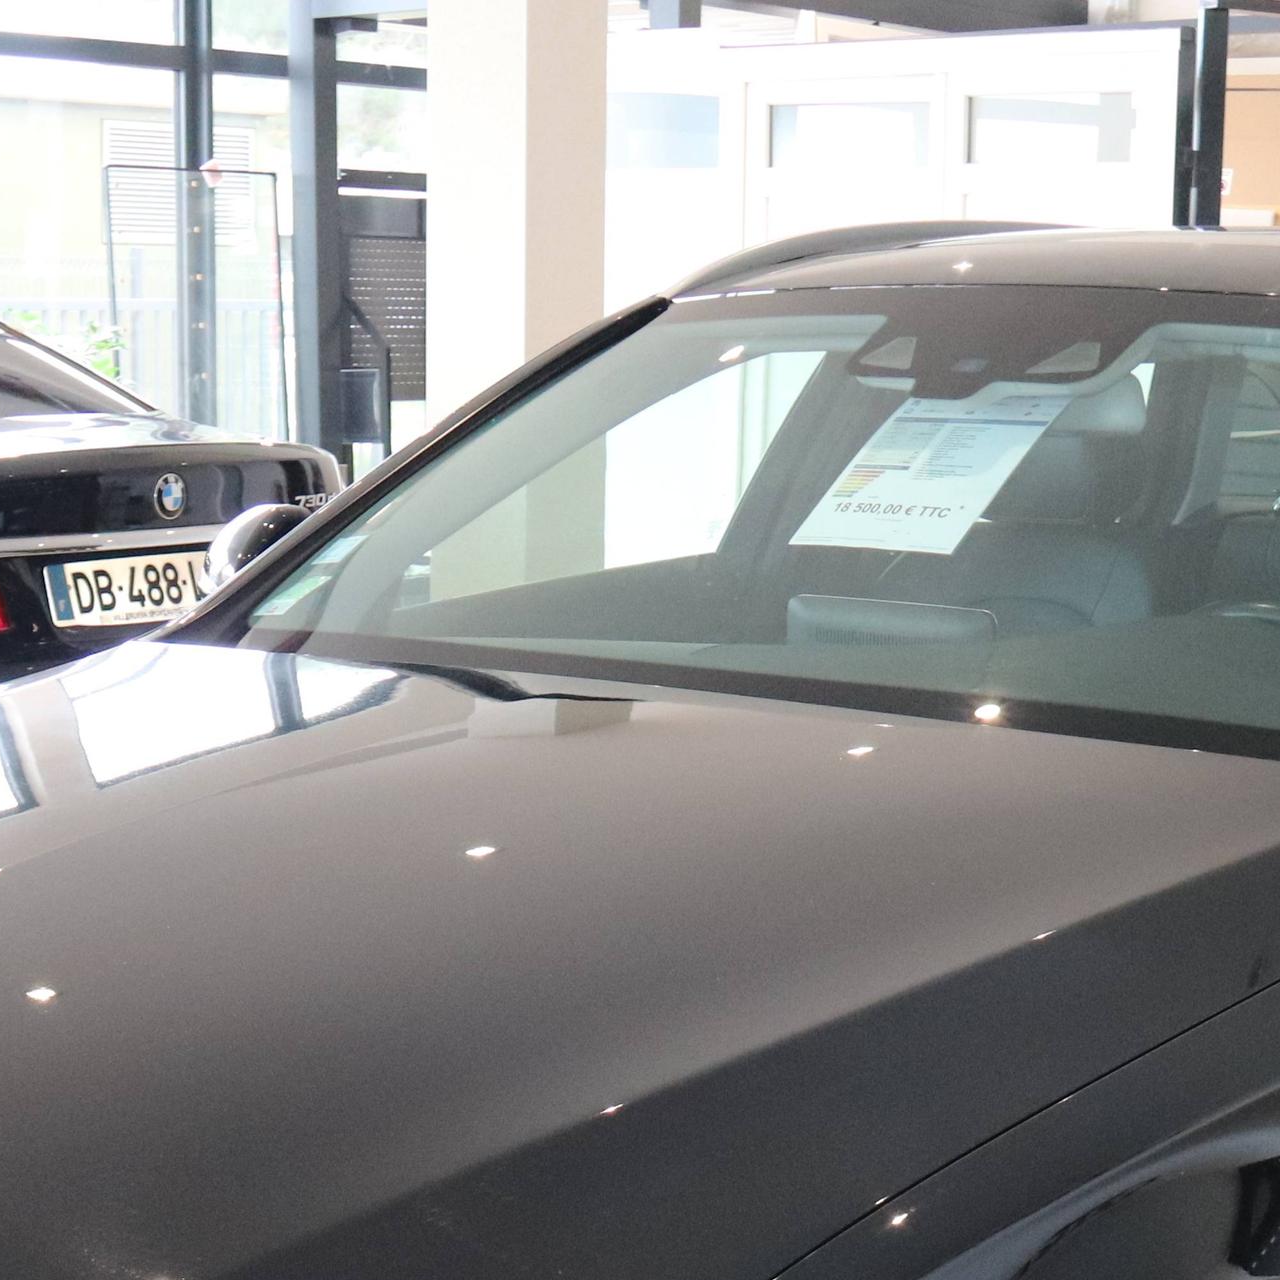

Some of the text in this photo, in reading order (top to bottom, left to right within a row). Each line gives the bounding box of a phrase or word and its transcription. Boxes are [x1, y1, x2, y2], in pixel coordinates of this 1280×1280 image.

[833, 501, 952, 518] 18 500,00 € TTC
